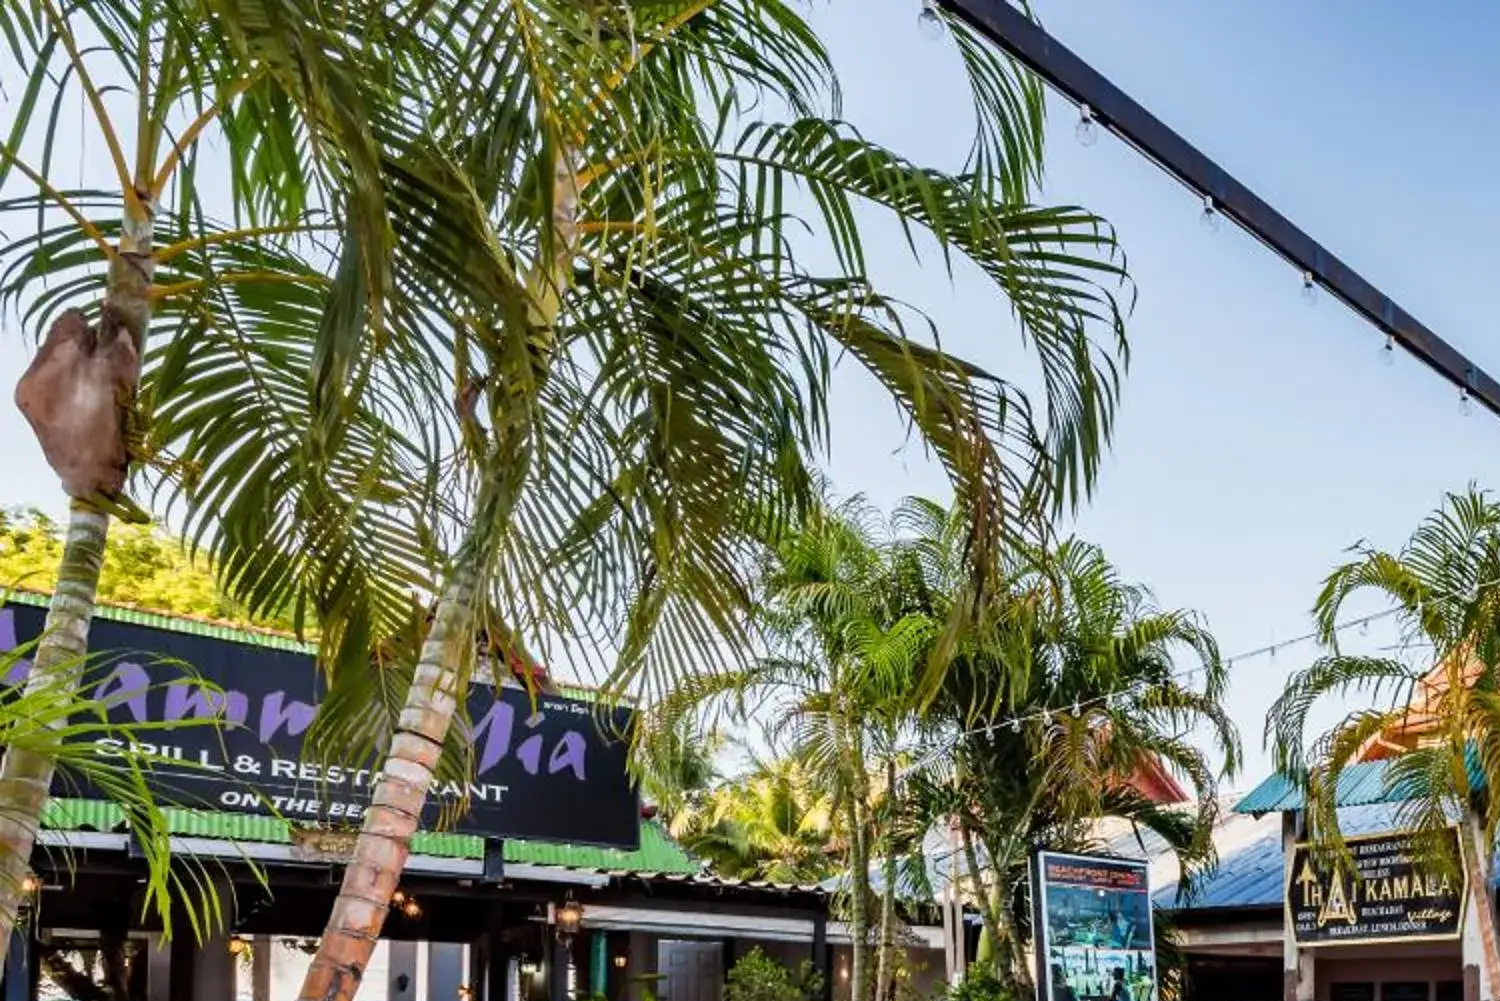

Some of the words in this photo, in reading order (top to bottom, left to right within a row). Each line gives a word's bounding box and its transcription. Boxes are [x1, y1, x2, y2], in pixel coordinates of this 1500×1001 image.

[233, 754, 261, 775] &
[220, 791, 260, 807] ON
[271, 796, 323, 813] THE
[1365, 872, 1453, 902] KAMALA
